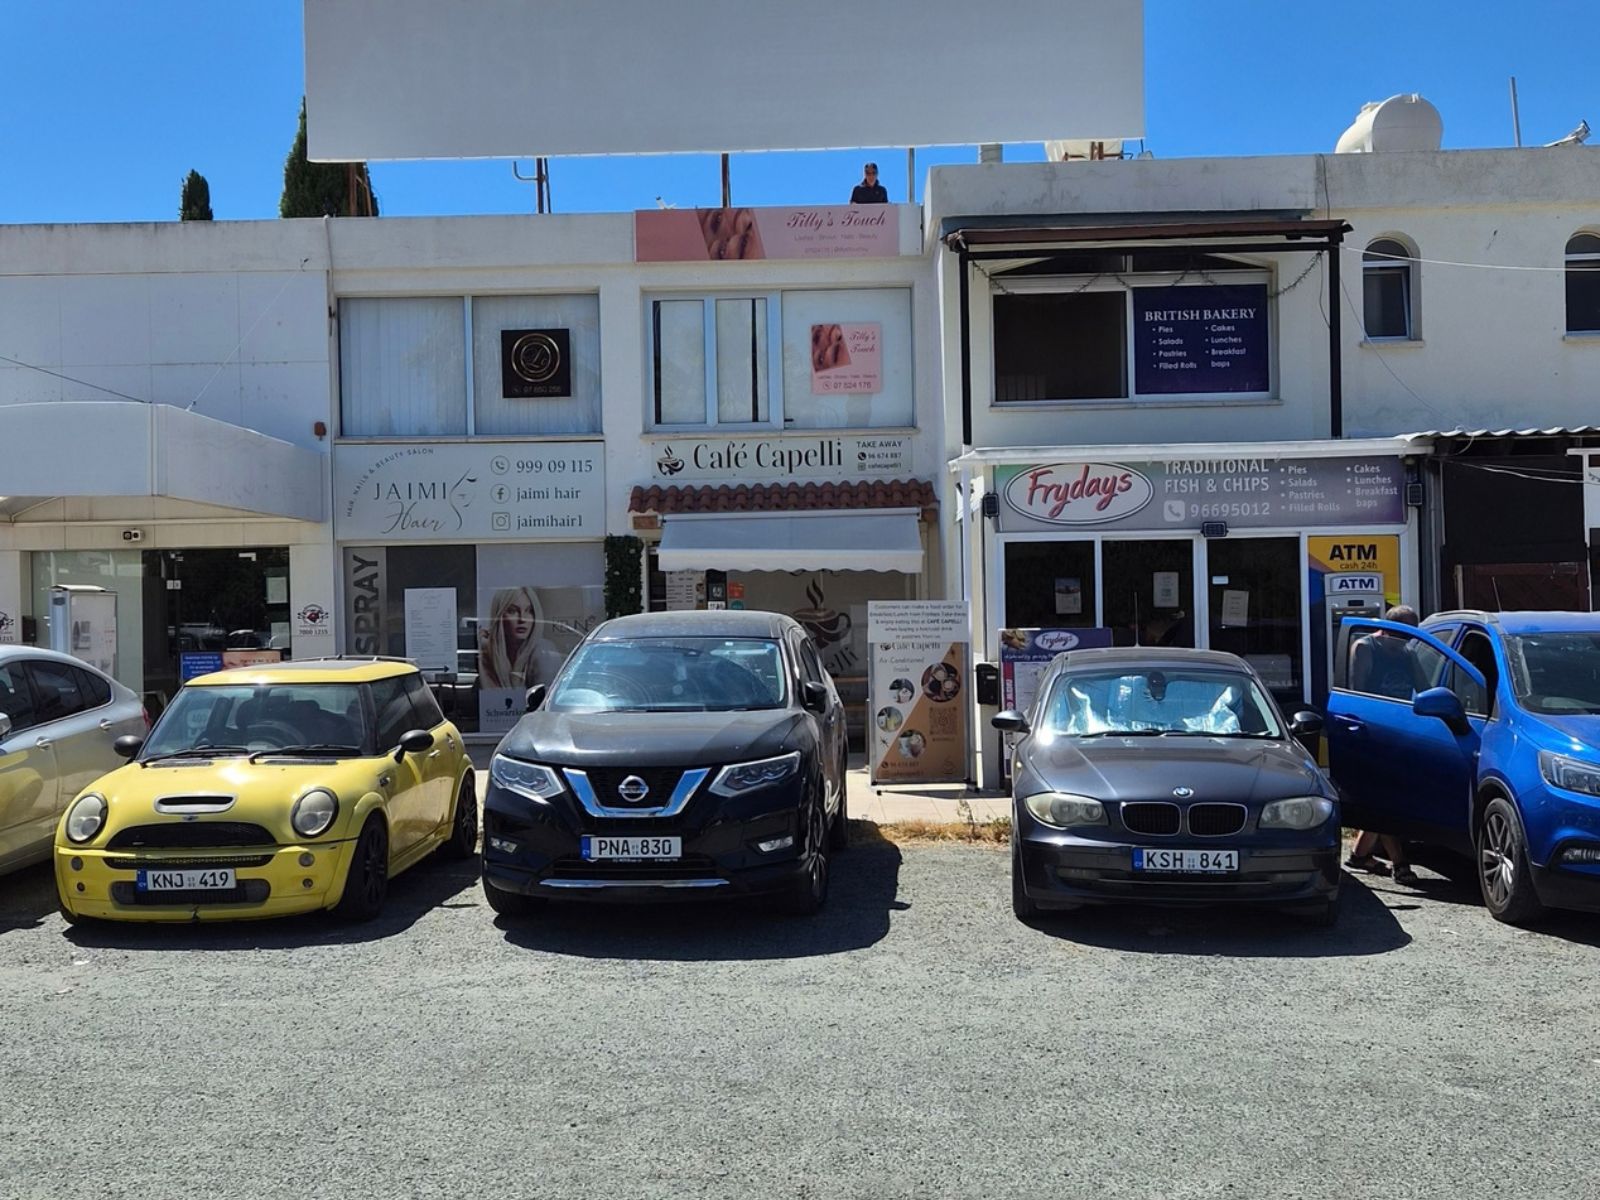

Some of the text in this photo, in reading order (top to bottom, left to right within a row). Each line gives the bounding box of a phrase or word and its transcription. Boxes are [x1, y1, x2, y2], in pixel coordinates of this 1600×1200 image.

[787, 210, 886, 231] Tilly's Touch
[1145, 308, 1256, 321] BRITISH BAKERY
[1211, 324, 1235, 332] Cakes
[856, 440, 877, 448] TAKE
[694, 440, 842, 473] Café Capelli
[516, 459, 593, 473] 999 09 115
[1164, 459, 1269, 474] TRADITIONAL
[1288, 466, 1307, 474] Pies
[1354, 464, 1380, 473] Cakes
[1165, 477, 1270, 493] FISH & CHIPS
[1288, 478, 1317, 487] Salads
[1354, 475, 1392, 485] Lunches
[374, 482, 447, 500] JAIMI
[516, 487, 581, 503] jaimi hair
[1027, 464, 1133, 518] Frydays
[1289, 491, 1325, 500] Pastries
[1355, 486, 1399, 496] Breakfast
[1190, 502, 1270, 517] 96695012
[1289, 502, 1341, 512] Filled Rolls
[1356, 499, 1378, 508] baps
[381, 501, 444, 534] Hair
[1329, 545, 1377, 560] ATM
[1361, 561, 1377, 569] 24h
[1338, 579, 1375, 589] ATM
[353, 554, 380, 656] SPRAY
[598, 840, 631, 855] PNA
[640, 839, 672, 855] 830
[1146, 852, 1184, 868] KSH
[1200, 853, 1235, 869] 841
[152, 873, 184, 888] KNJ
[199, 872, 229, 887] 419
